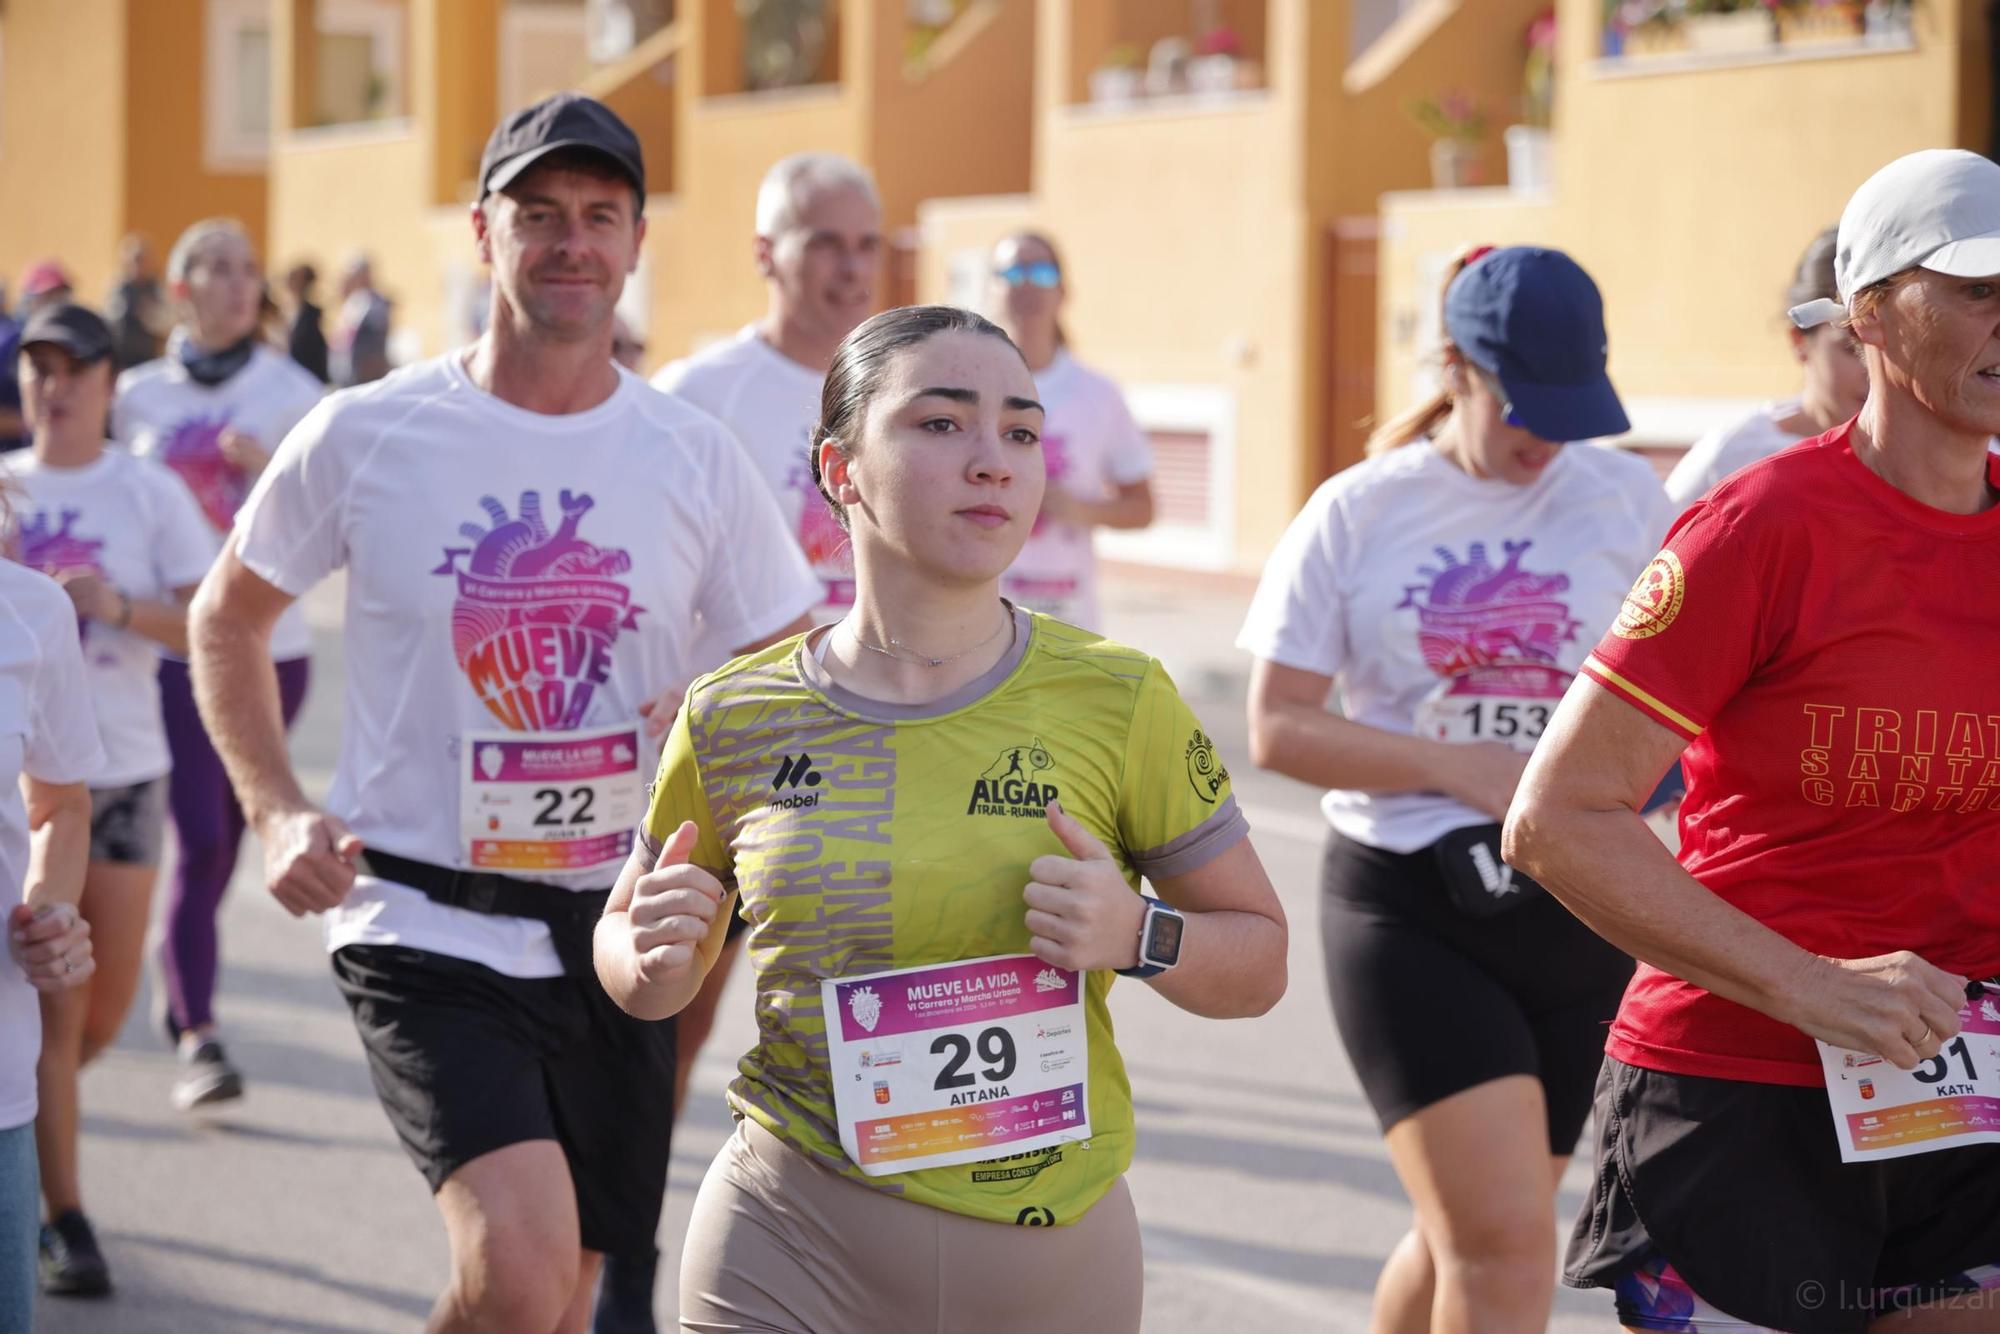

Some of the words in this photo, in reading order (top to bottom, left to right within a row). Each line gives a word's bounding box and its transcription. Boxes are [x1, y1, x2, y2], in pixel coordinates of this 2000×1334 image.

[467, 625, 611, 698] MUEVE
[1463, 702, 1548, 738] 153
[1801, 749, 2000, 786] SANTA
[533, 786, 595, 826] 22
[771, 792, 819, 813] mobel
[907, 980, 962, 1000] MUEVE
[966, 977, 983, 992] LA
[986, 971, 1019, 988] VIDA
[907, 1002, 917, 1011] VI
[918, 996, 953, 1010] Carrera
[954, 997, 961, 1006] y
[961, 992, 992, 1004] Marcha
[993, 986, 1021, 999] Urbana
[930, 1026, 1016, 1091] 29
[855, 1073, 862, 1081] S
[1937, 1084, 1975, 1097] KATH
[950, 1086, 1010, 1106] AITANA
[975, 1171, 1011, 1181] EMPRESA
